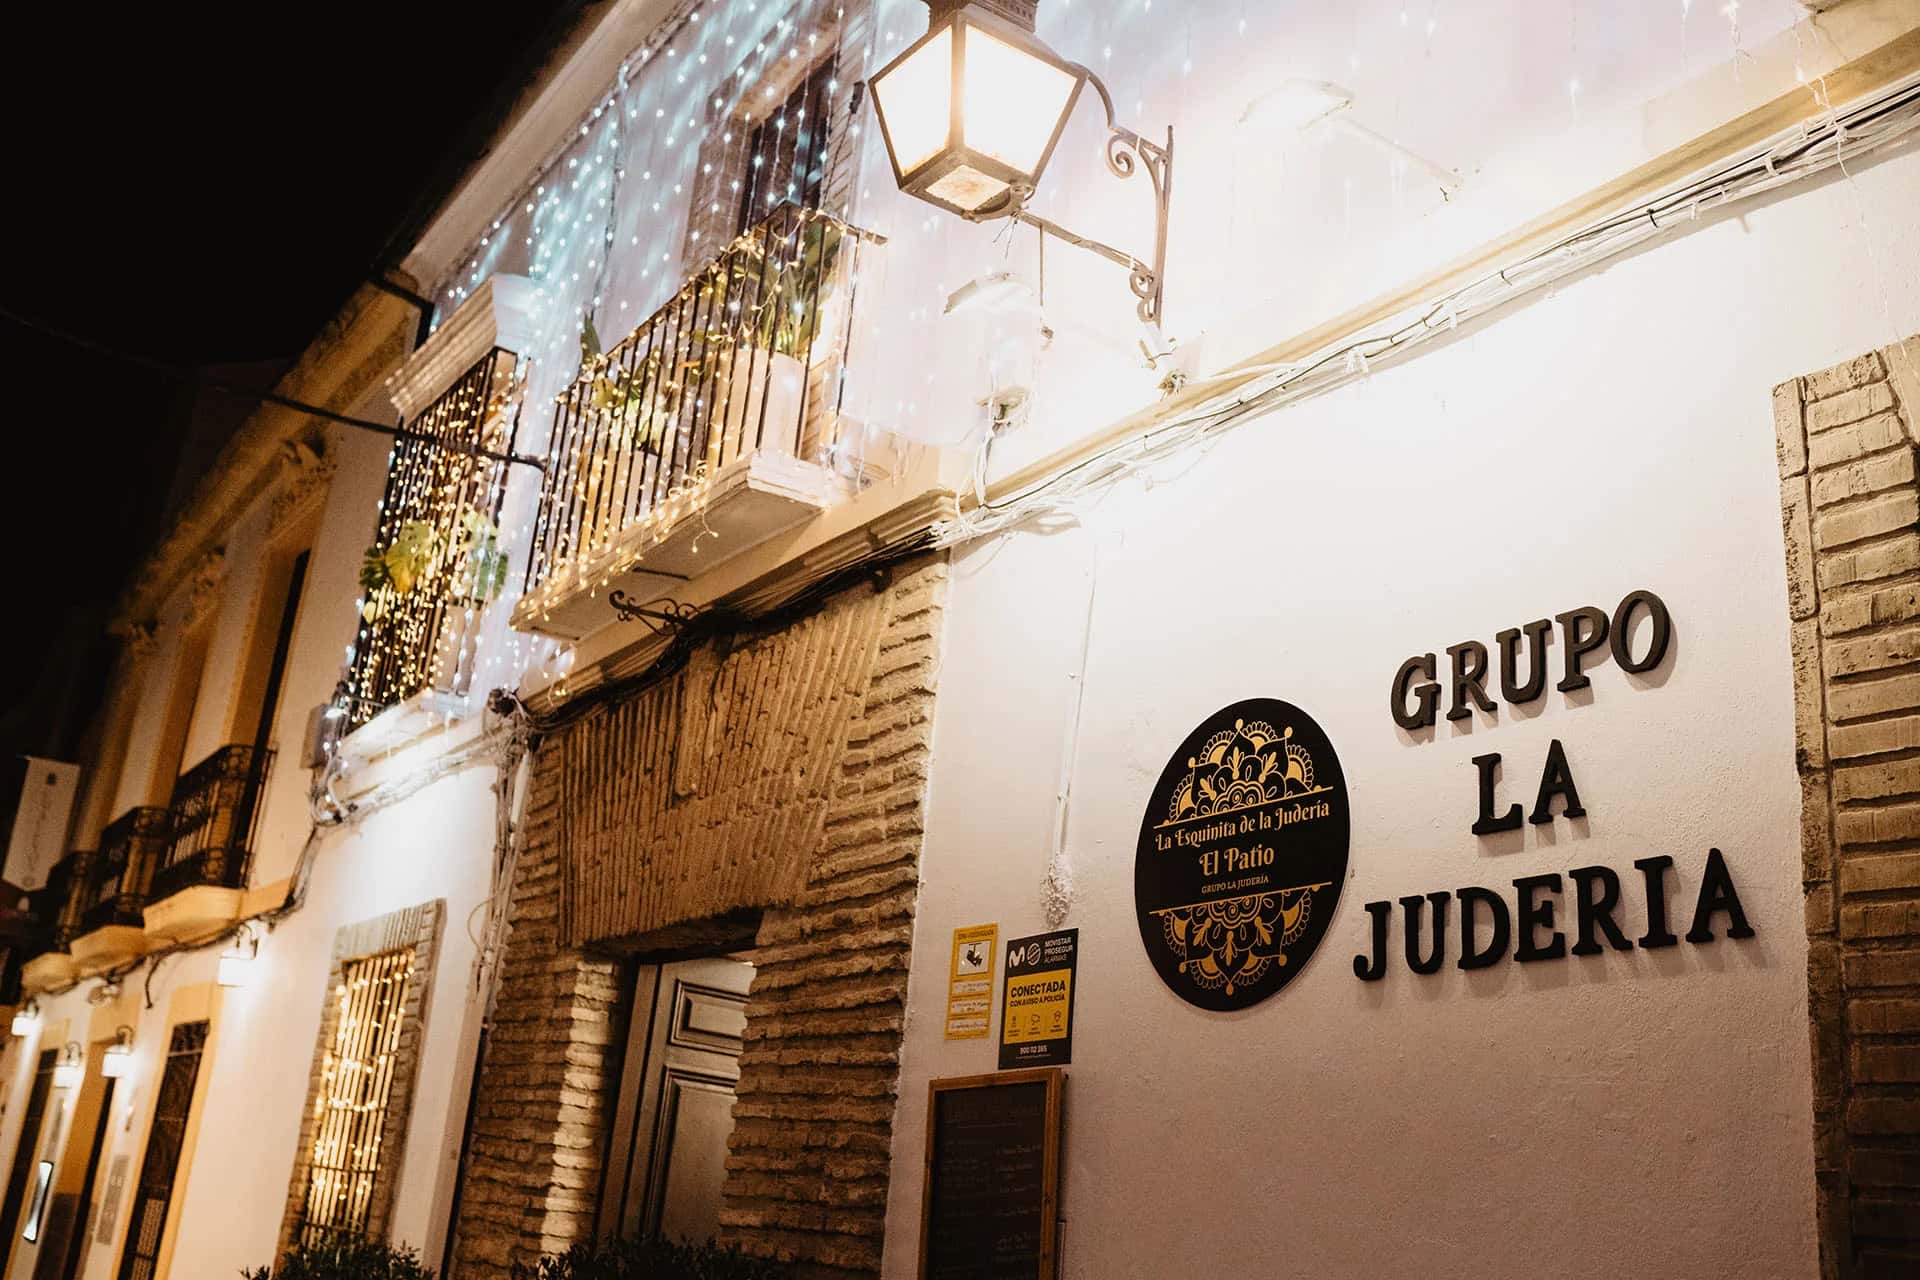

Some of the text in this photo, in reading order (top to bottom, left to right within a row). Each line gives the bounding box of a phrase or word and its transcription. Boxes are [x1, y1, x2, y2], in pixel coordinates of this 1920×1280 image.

[1390, 589, 1671, 730] GRUPO
[1471, 738, 1587, 835] LA
[1155, 800, 1329, 851] La Esquinita de la Judería
[1199, 844, 1274, 876] El Patio
[1201, 881, 1226, 894] GRUPO
[1227, 880, 1237, 890] LA
[1352, 847, 1756, 981] JUDERIA
[1044, 945, 1073, 955] PROSEGUR
[1045, 936, 1071, 947] MOVISTAR
[1010, 980, 1066, 998] CONECTADA
